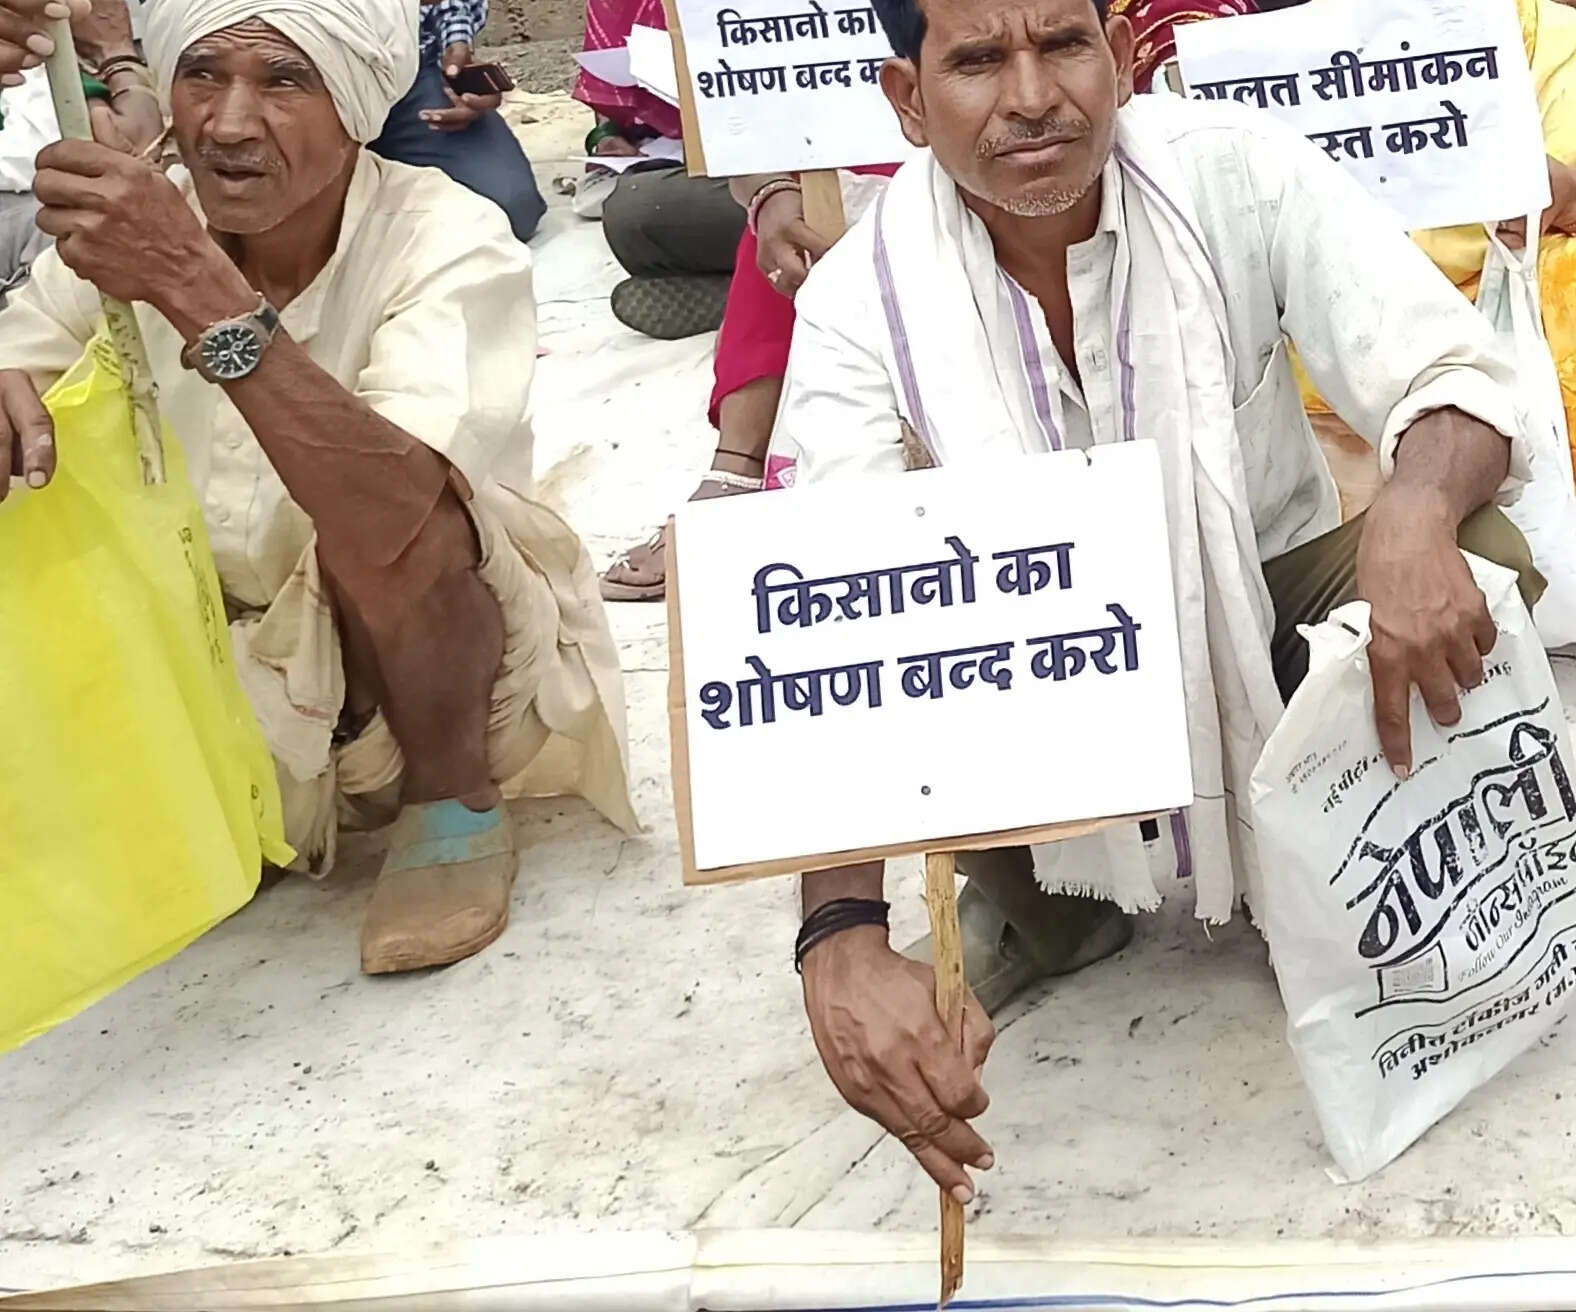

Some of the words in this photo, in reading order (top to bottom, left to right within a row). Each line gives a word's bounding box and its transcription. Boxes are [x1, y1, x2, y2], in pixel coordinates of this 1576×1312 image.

[716, 0, 830, 47] किसानो
[834, 7, 877, 36] का
[697, 58, 787, 99] शोषण
[792, 60, 852, 90] बन्द
[1309, 41, 1499, 101] सीमांकन
[1381, 100, 1469, 156] करो
[752, 535, 979, 633] किसानो
[991, 541, 1075, 596] का
[699, 654, 883, 731] शोषण
[897, 640, 1014, 699] बन्द
[1026, 603, 1142, 682] करो
[1346, 721, 1573, 958] नेपाली
